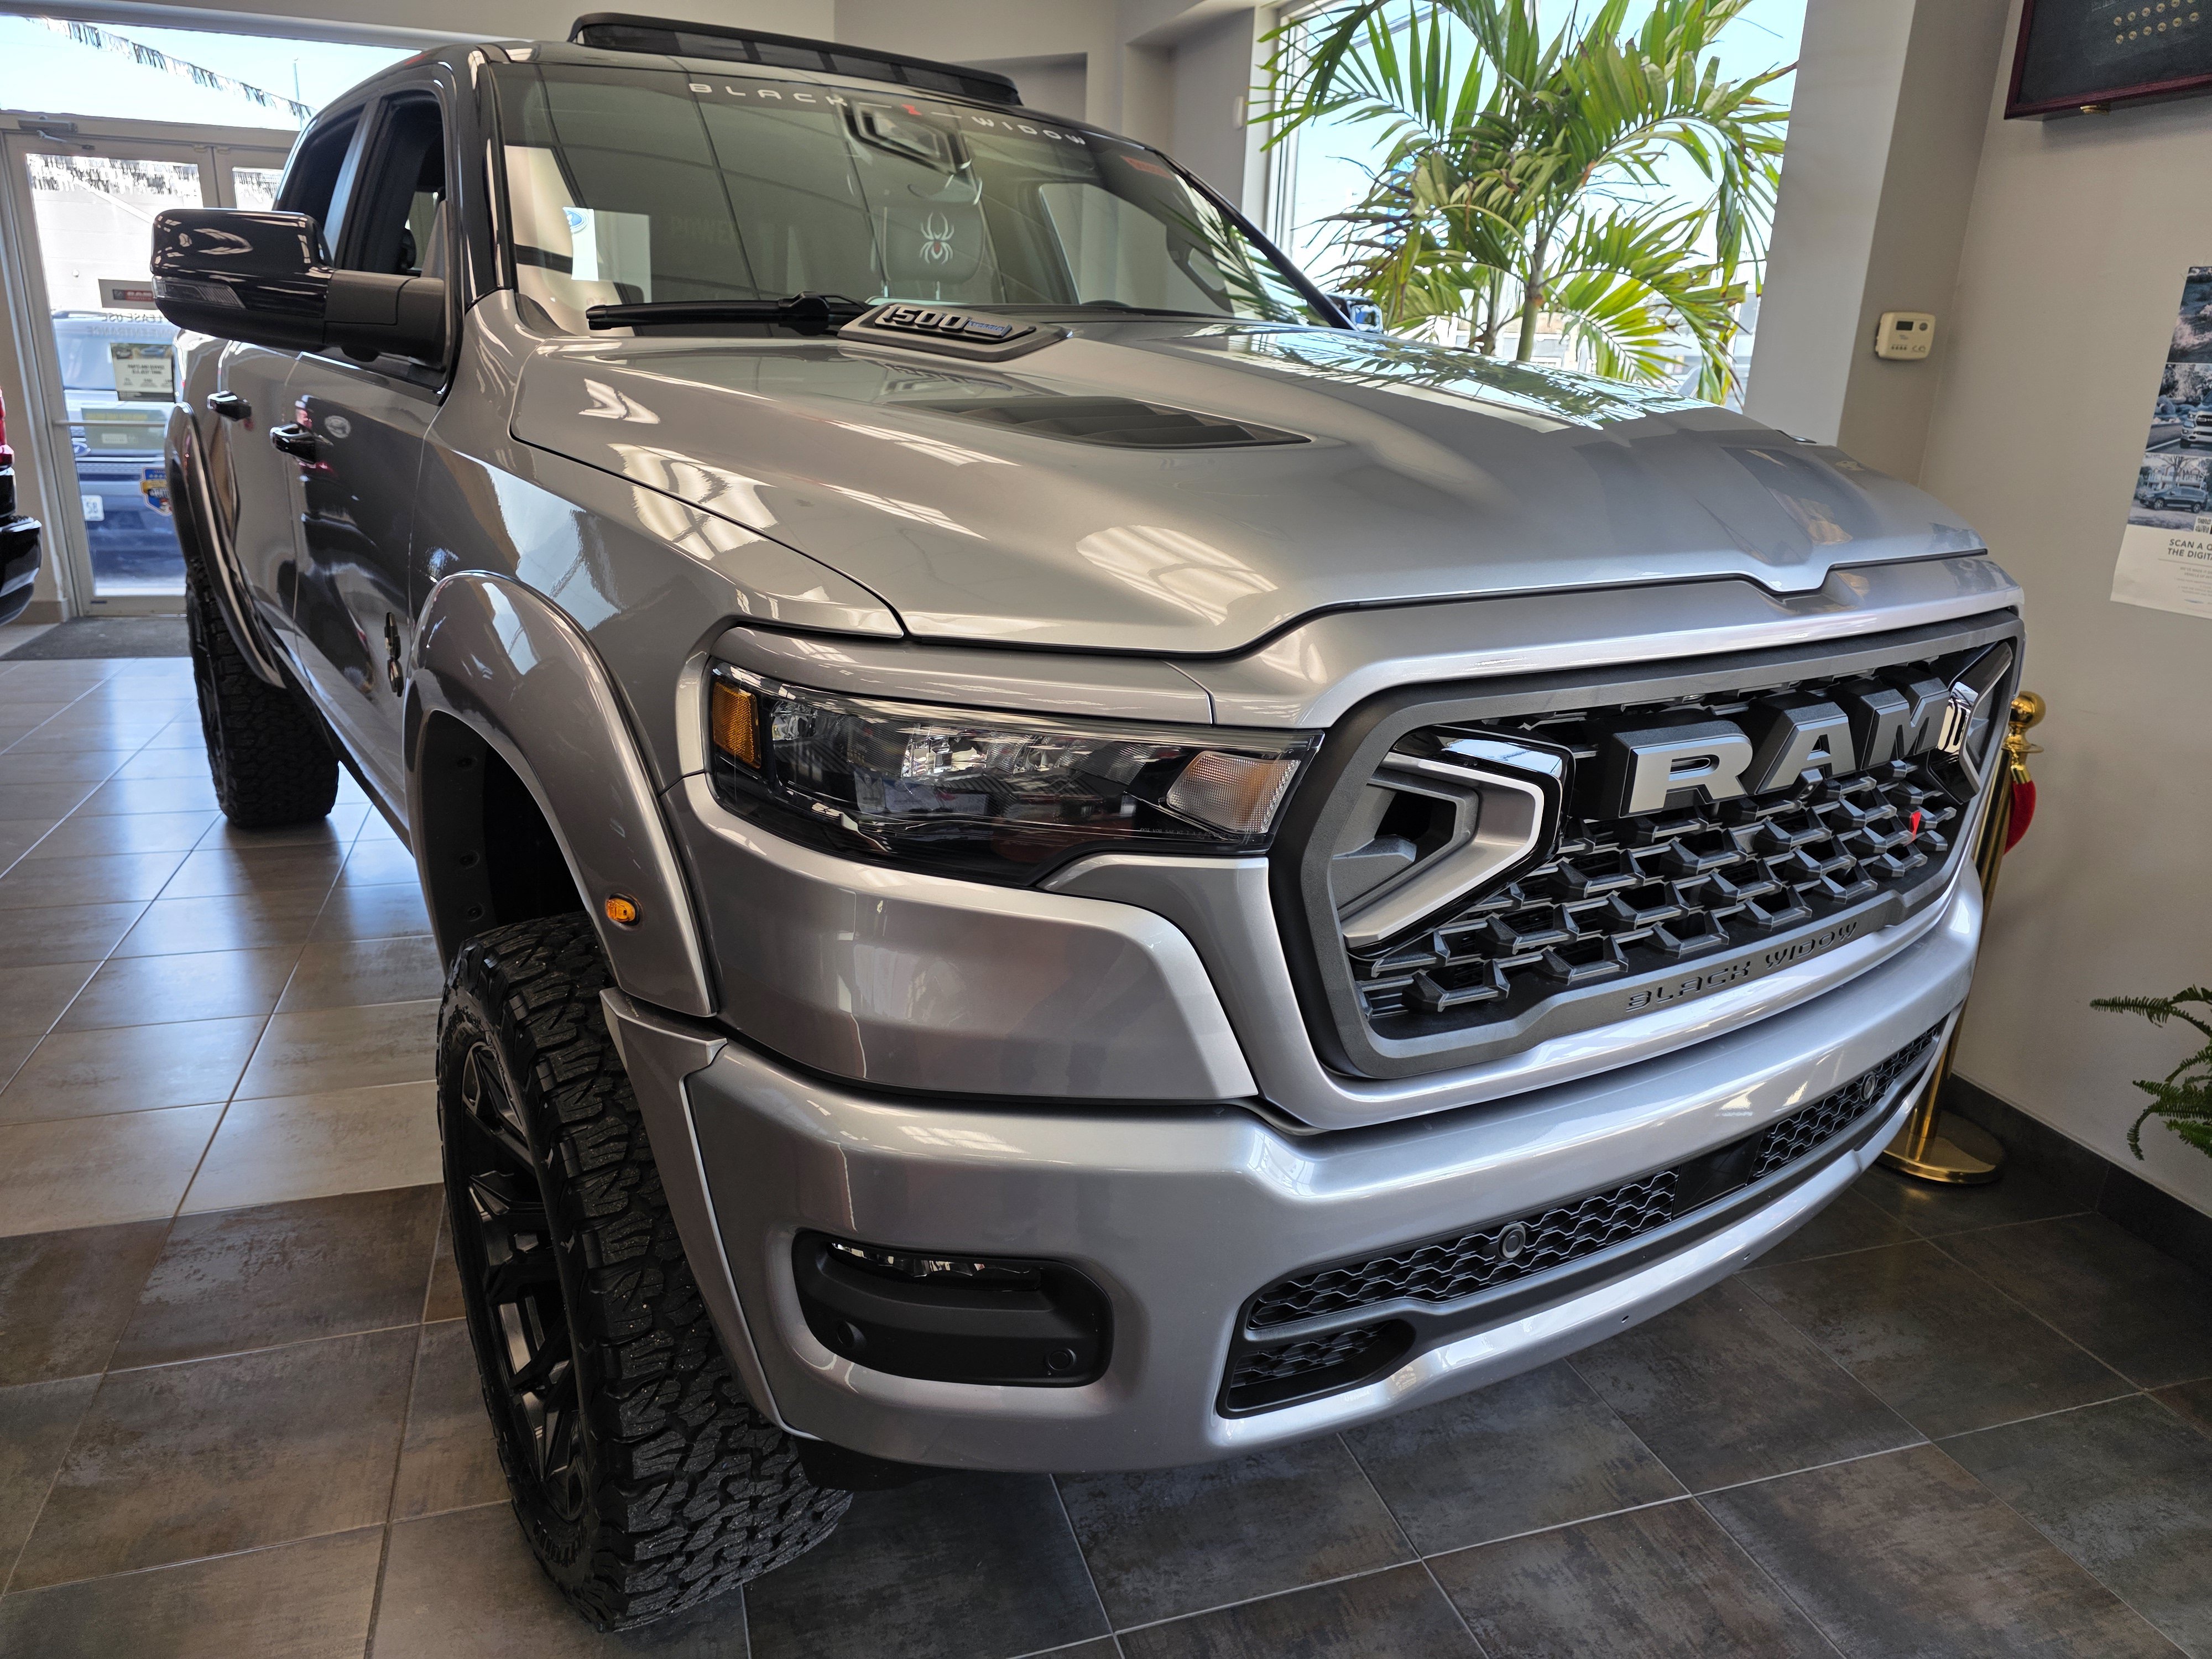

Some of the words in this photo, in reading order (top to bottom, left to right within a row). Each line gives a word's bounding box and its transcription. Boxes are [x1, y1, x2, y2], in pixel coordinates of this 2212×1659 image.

[689, 84, 847, 106] BLACK
[971, 116, 1086, 145] WIDOW
[883, 305, 969, 332] 1500
[2168, 547, 2184, 556] THE
[2169, 539, 2194, 548] SCAN
[2197, 542, 2203, 550] A
[1620, 691, 1949, 817] RAM
[1626, 961, 1750, 1011] BLACK
[1765, 921, 1857, 969] WIDOW
